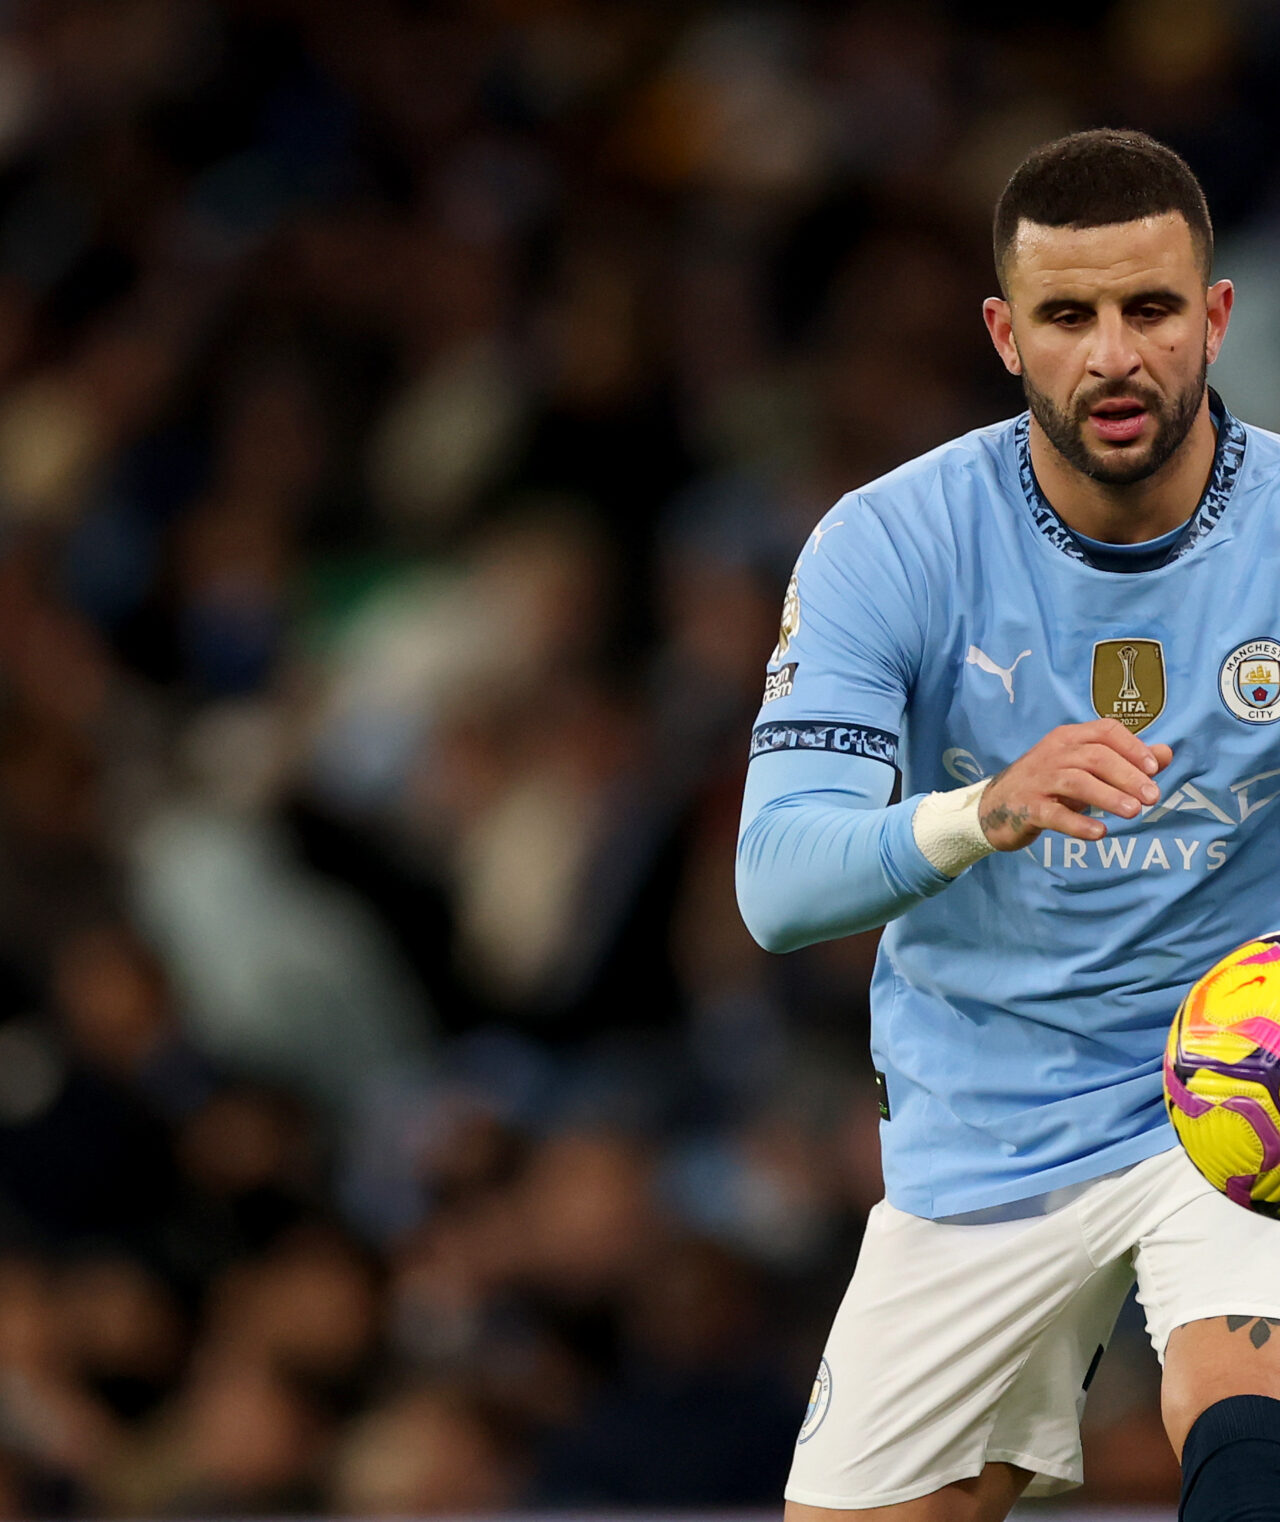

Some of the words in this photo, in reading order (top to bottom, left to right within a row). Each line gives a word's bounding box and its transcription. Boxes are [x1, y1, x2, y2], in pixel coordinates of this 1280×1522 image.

[1113, 701, 1146, 713] FIFA
[1248, 710, 1273, 719] CITY
[1120, 718, 1139, 726] 2023
[1024, 836, 1228, 871] IRWAYS
